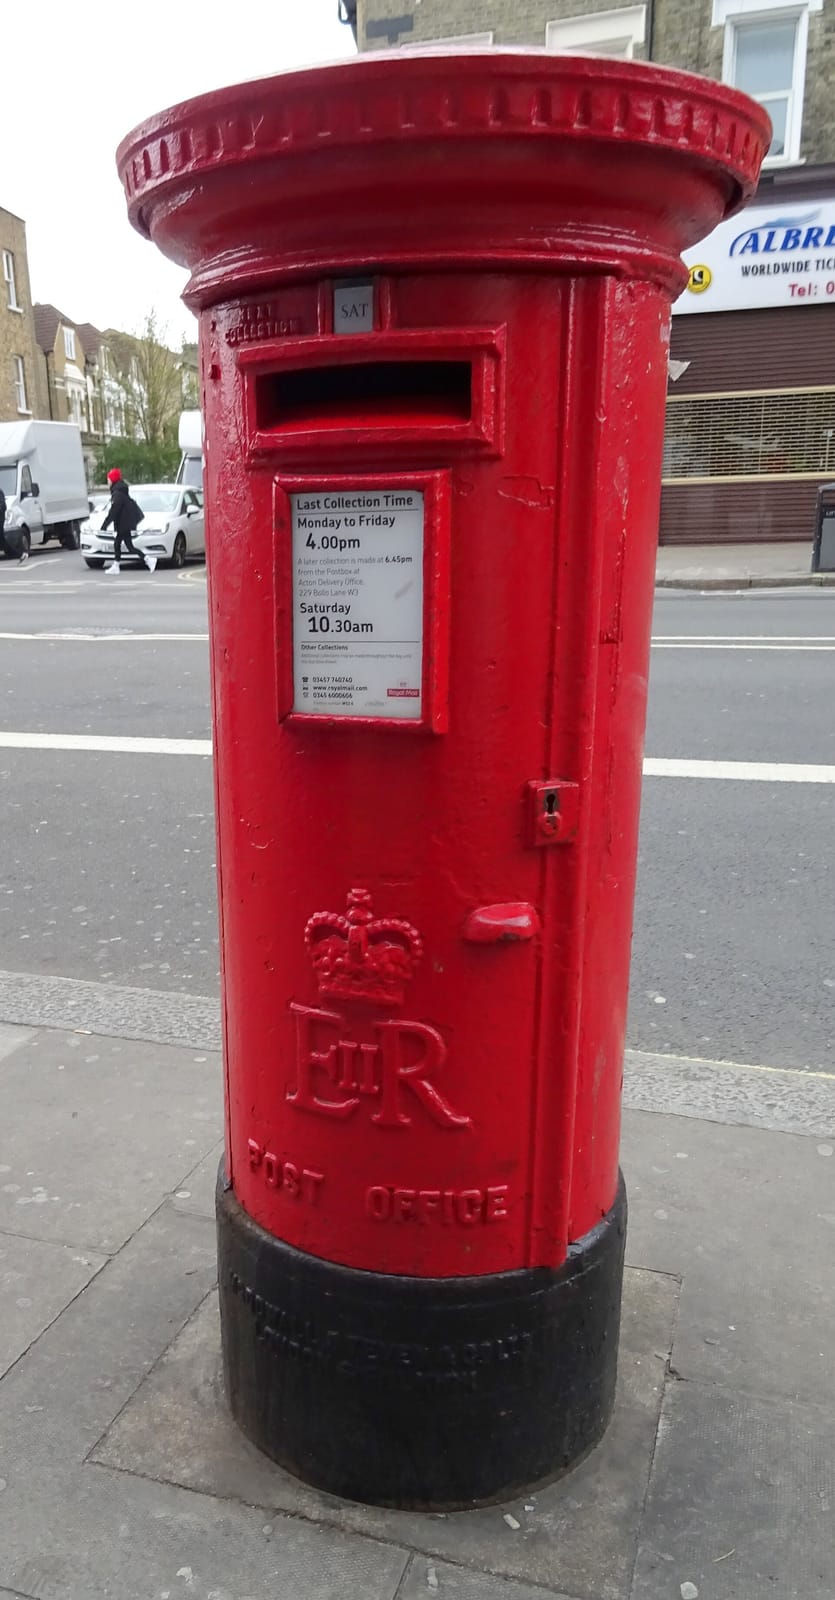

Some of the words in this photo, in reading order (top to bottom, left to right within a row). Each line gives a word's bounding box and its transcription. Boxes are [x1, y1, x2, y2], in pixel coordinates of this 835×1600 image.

[741, 259, 810, 277] WORLDWIDE
[815, 257, 835, 271] TIC
[788, 282, 818, 297] Tel:
[341, 303, 369, 319] SAT
[296, 498, 321, 510] Last
[323, 496, 380, 509] Collection
[383, 494, 413, 507] Time
[297, 517, 341, 530] Monday
[344, 516, 356, 527] to
[359, 514, 396, 528] Friday
[305, 532, 360, 552] 4.00pm
[385, 555, 413, 564] 6.45pm
[300, 602, 351, 615] Saturday
[308, 615, 374, 633] 10.30am
[247, 1137, 325, 1201] POST
[366, 1184, 509, 1223] OFFICE
